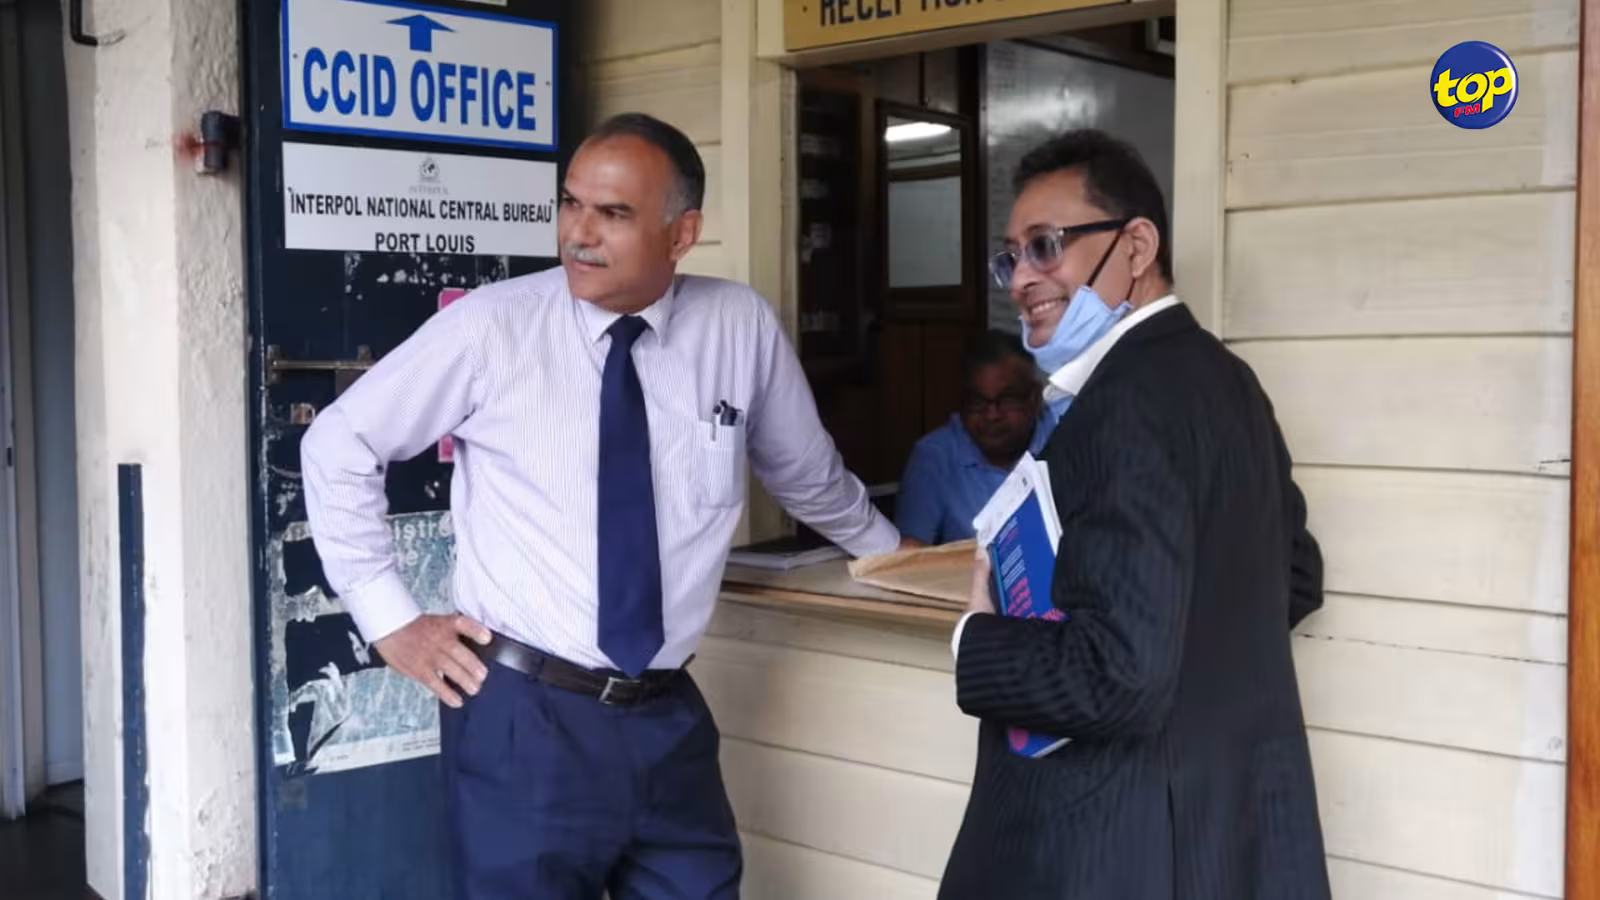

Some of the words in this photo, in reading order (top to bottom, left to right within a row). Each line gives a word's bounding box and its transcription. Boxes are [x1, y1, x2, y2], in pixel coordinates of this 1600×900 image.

[303, 47, 396, 117] CCID
[410, 59, 536, 131] OFFICE
[290, 193, 363, 216] INTERPOL
[367, 197, 436, 219] NATIONAL
[439, 200, 499, 221] CENTRAL
[503, 203, 552, 223] BUREAU
[375, 233, 420, 252] PORT
[426, 235, 475, 253] LOUIS
